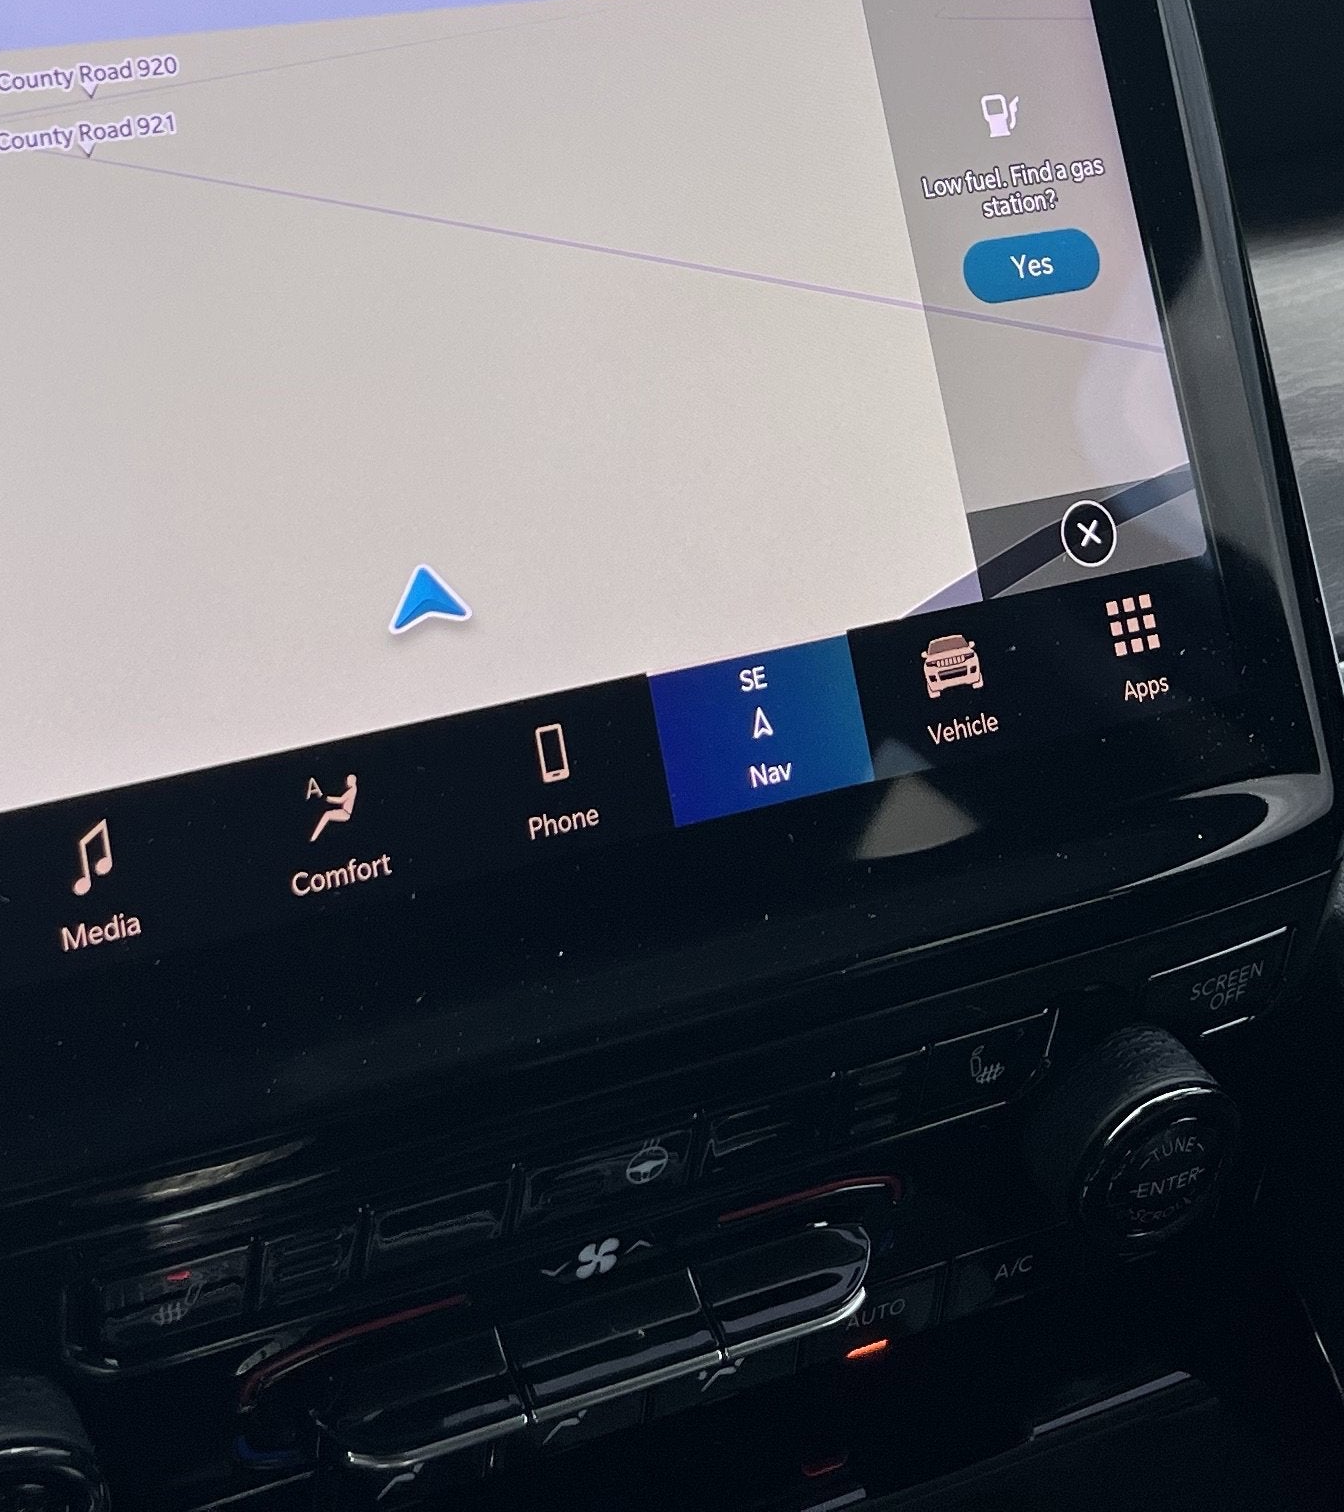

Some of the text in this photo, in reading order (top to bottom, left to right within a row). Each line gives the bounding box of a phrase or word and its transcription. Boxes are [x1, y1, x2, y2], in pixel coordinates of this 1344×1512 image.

[79, 60, 133, 83] Road
[137, 56, 178, 77] 920
[78, 119, 133, 141] Road
[137, 114, 175, 136] 921
[921, 158, 1104, 199] Low fuel. Find a gas
[982, 189, 1057, 218] station?
[1010, 254, 1054, 279] Yes
[738, 666, 768, 693] SE
[1123, 673, 1170, 703] Apps
[927, 712, 999, 746] Vehicle
[749, 761, 793, 789] Nav
[527, 805, 600, 841] Phone
[290, 852, 393, 897] Comfort
[60, 913, 142, 953] Media
[1190, 959, 1265, 1001] SCREEN
[1208, 982, 1249, 1011] OFF
[1149, 1136, 1197, 1162] TUNE
[1136, 1166, 1201, 1198] ENTER
[993, 1253, 1035, 1282] A/C
[844, 1298, 907, 1331] AUTO
